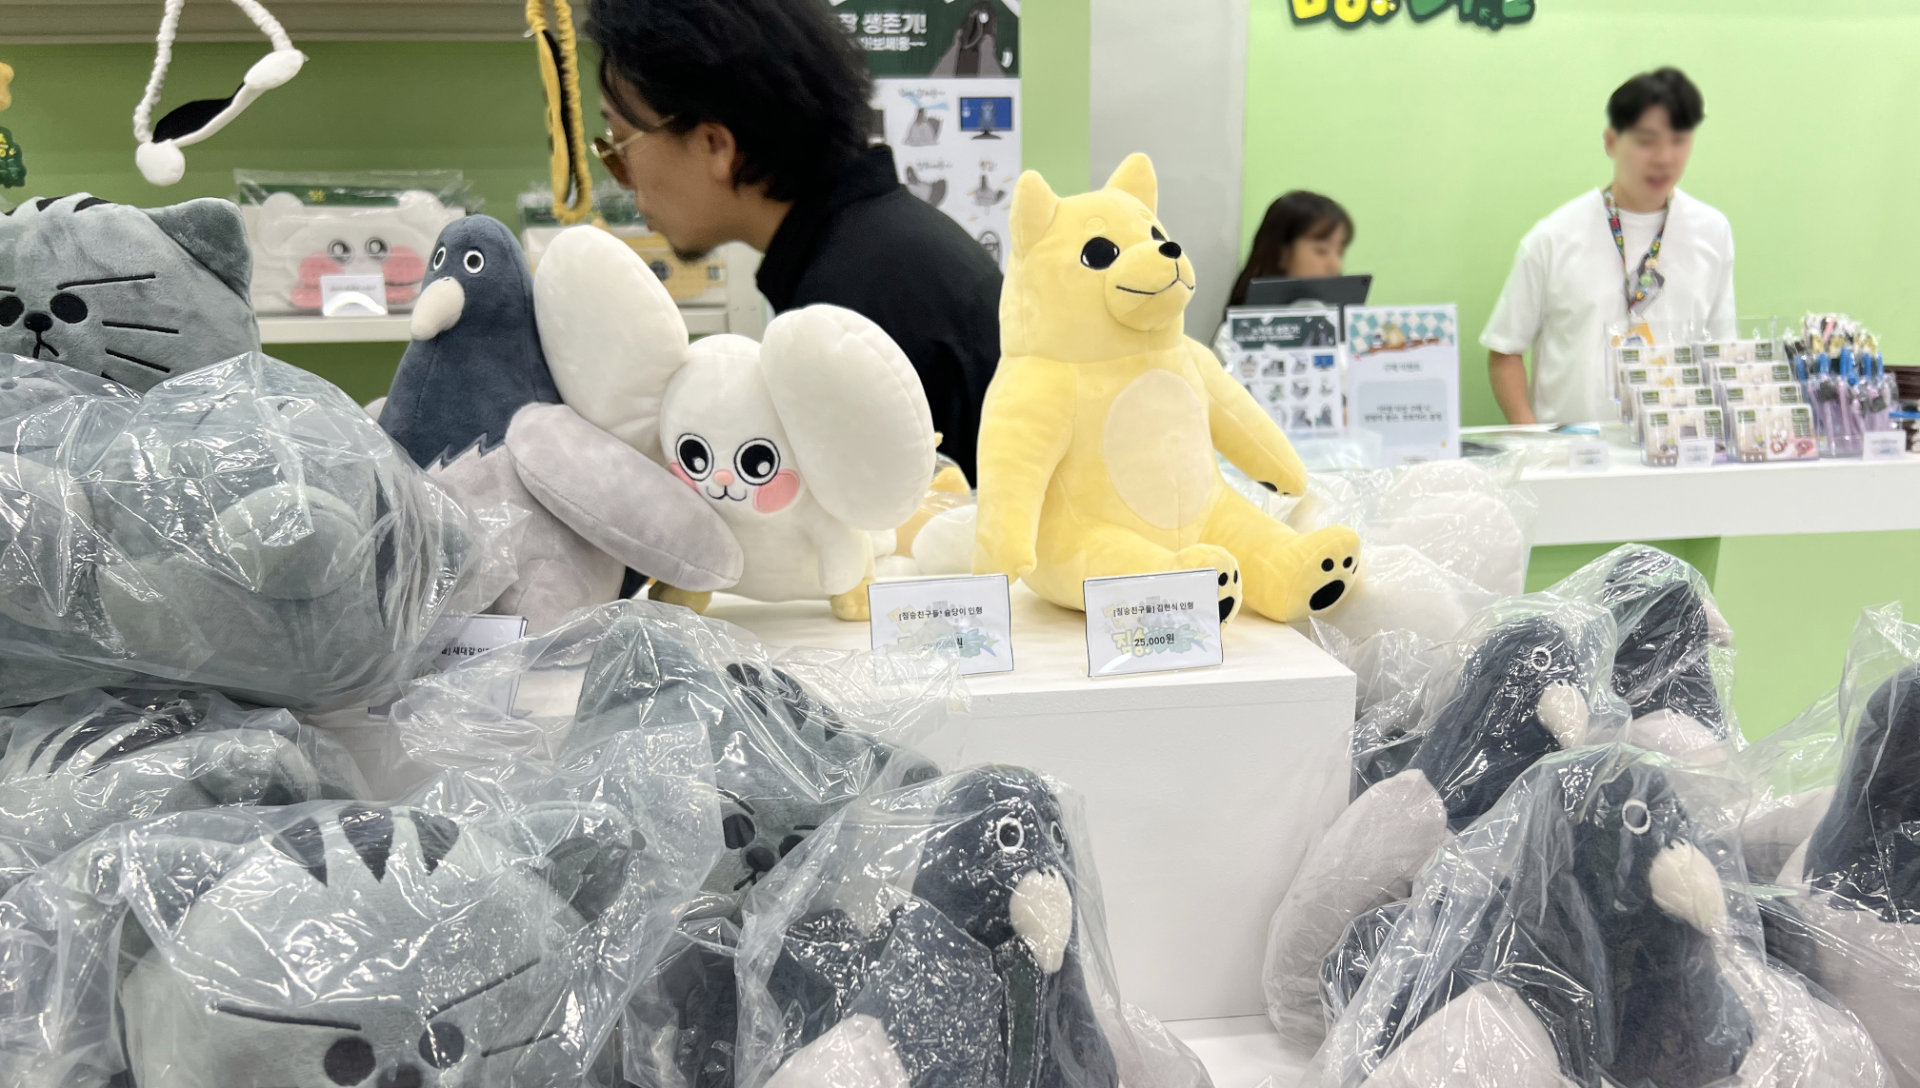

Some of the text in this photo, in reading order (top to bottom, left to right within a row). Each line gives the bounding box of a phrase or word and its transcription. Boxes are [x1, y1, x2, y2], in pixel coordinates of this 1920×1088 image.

[862, 13, 927, 34] 생존기!
[968, 606, 983, 615] 인형
[1157, 603, 1178, 612] 김현식
[1179, 601, 1194, 610] 인형
[1134, 633, 1175, 647] 25,000원
[452, 646, 476, 656] 새대갈
